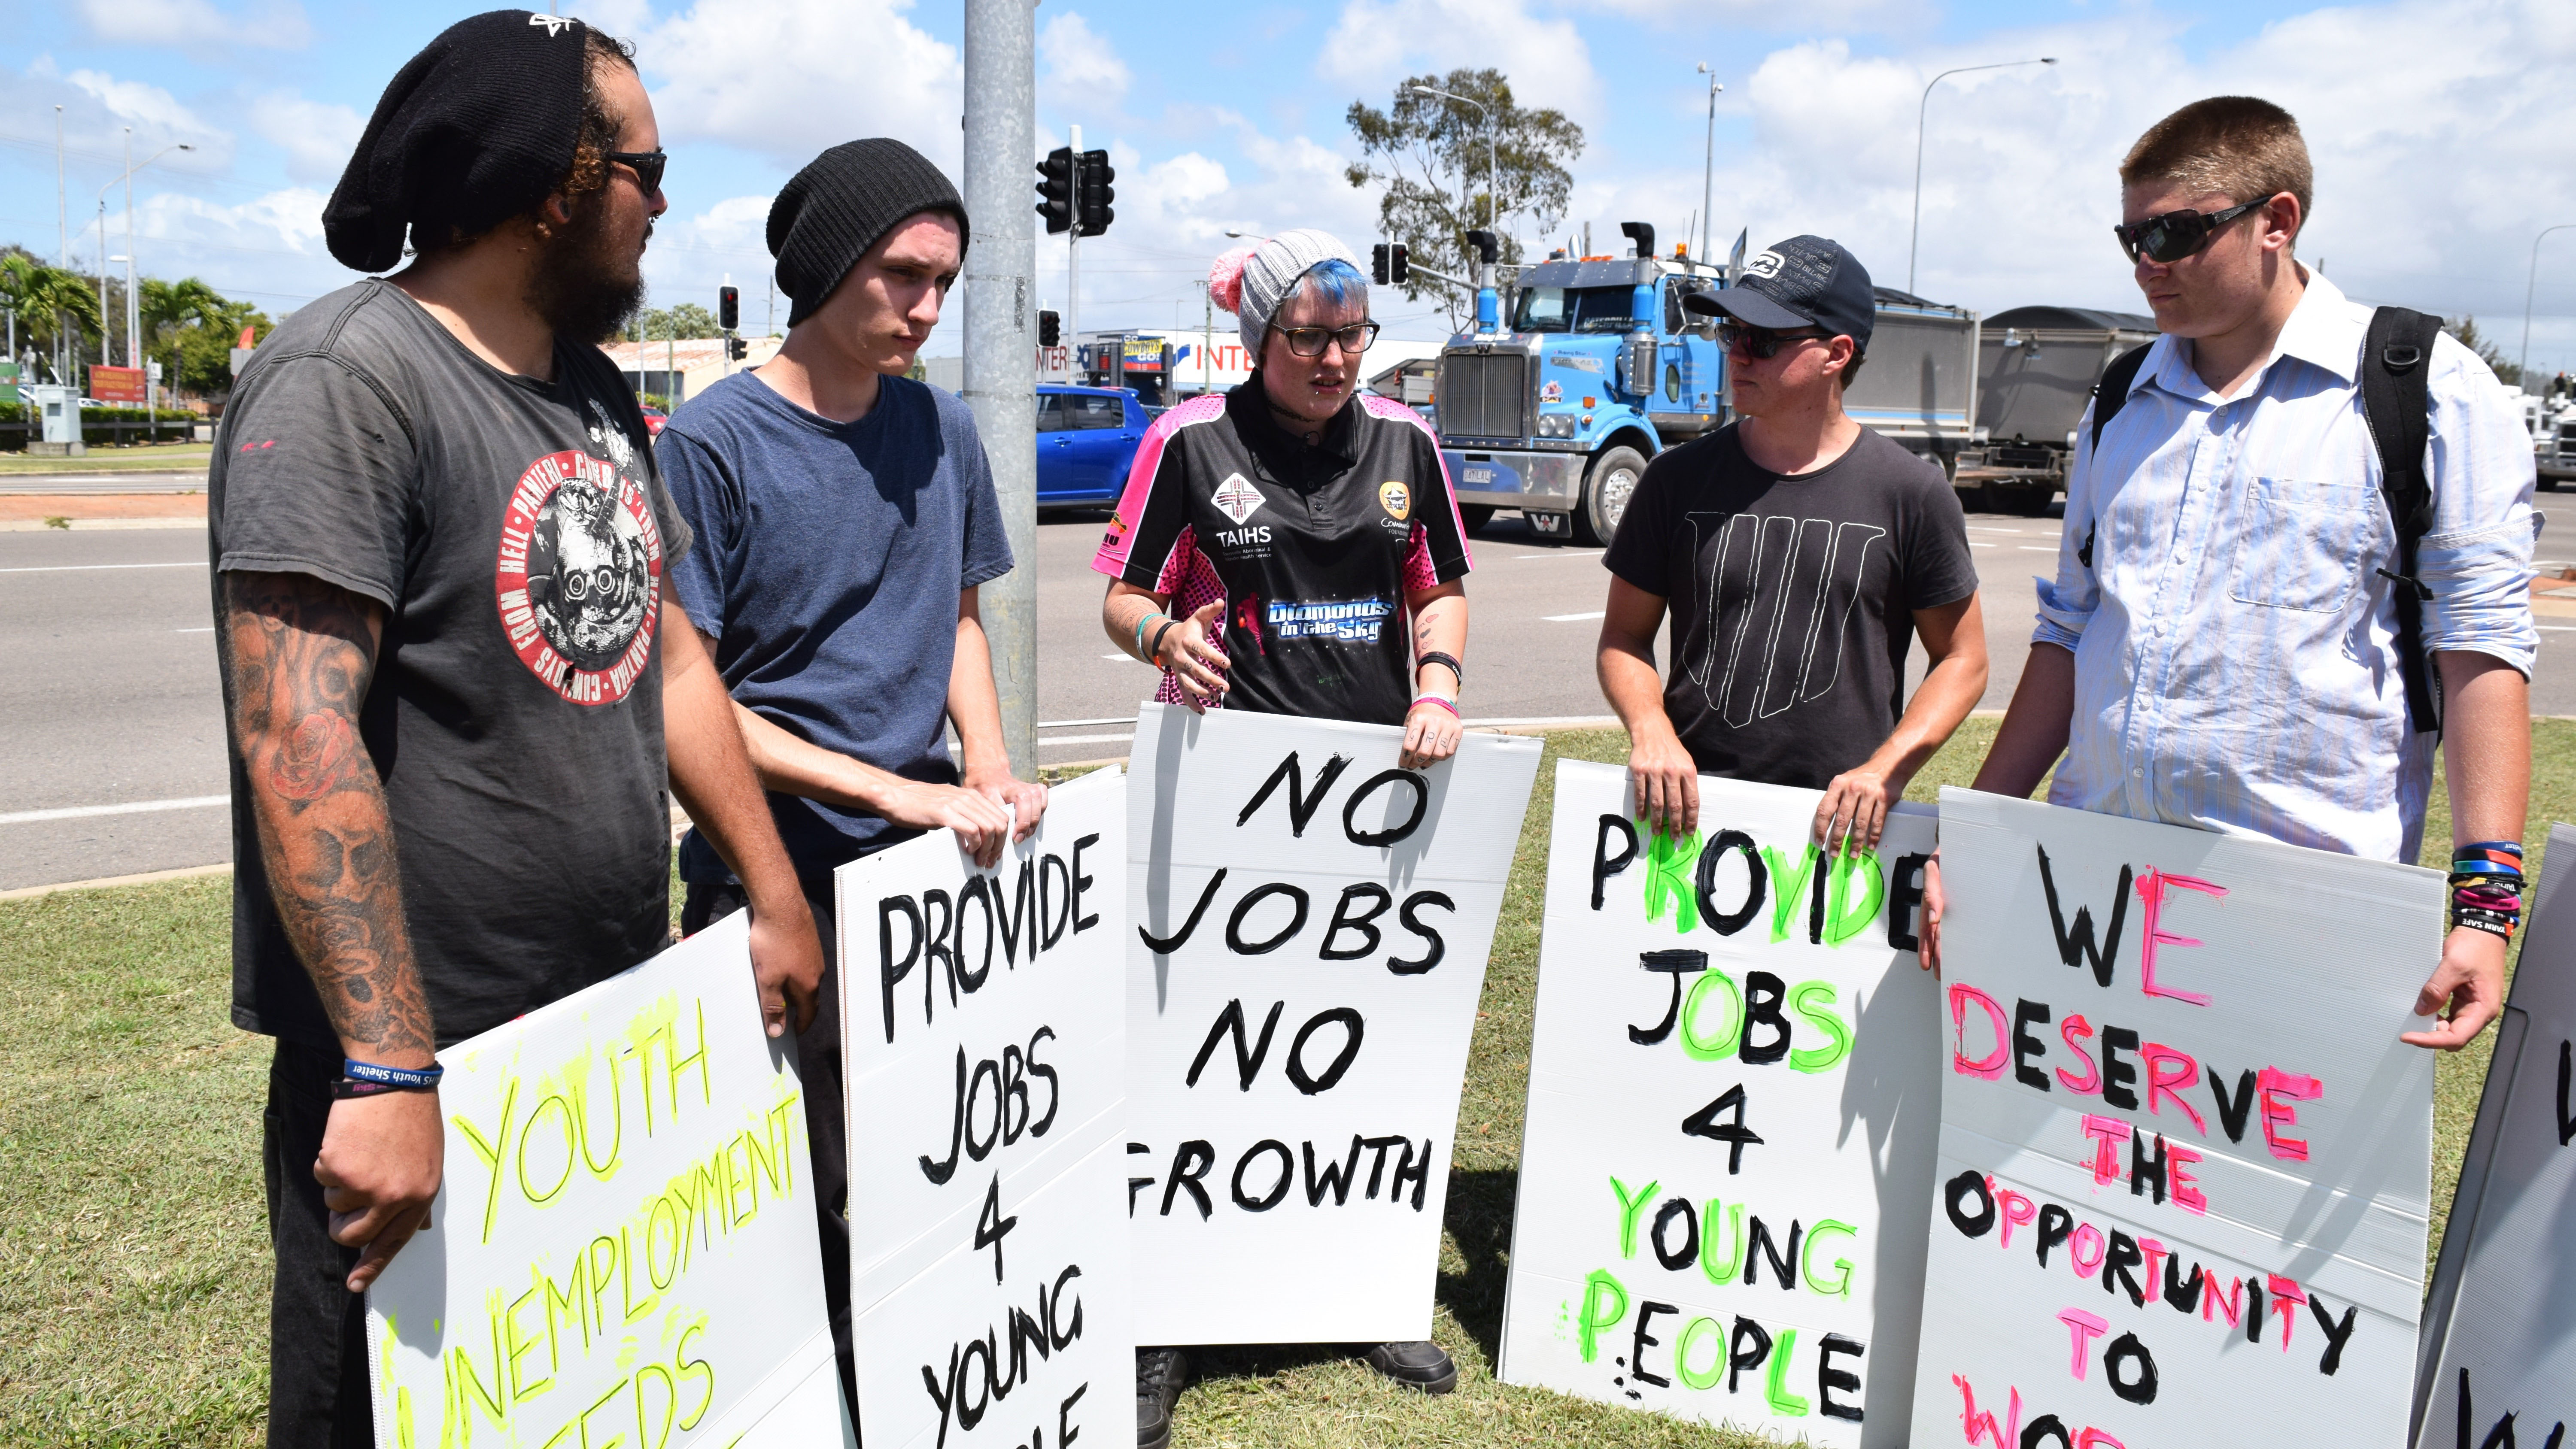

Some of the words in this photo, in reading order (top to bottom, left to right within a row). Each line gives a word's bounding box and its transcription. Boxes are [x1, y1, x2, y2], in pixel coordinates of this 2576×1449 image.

[1137, 353, 1160, 361] GO!
[499, 526, 530, 573] HELL
[638, 504, 660, 562] FROM
[1216, 526, 1271, 548] TAIHS
[500, 588, 540, 651] FROM
[1269, 597, 1393, 623] Diamonds
[1281, 623, 1299, 636] in
[1303, 622, 1337, 634] the
[1337, 620, 1382, 640] Sky
[1236, 751, 1431, 848] NO
[1138, 867, 1456, 976] JOBS
[1591, 813, 1926, 952] PROVIDE
[2037, 840, 2230, 1006] WE
[2462, 918, 2483, 928] SAFE
[2484, 921, 2506, 934] YARN
[879, 832, 1100, 1045] PROVIDE
[1186, 998, 1367, 1096] NO
[1628, 949, 1855, 1074] JOBS
[352, 1065, 391, 1080] Shelter
[393, 1072, 422, 1084] Youth
[451, 998, 712, 1244] YOUTH
[918, 1025, 1058, 1185] JOBS
[1947, 983, 2323, 1161] DESERVE
[1681, 1082, 1765, 1175] 4
[2079, 1113, 2208, 1216] THE
[396, 1091, 799, 1449] UNEMPLOYMENT
[973, 1168, 1019, 1285] 4
[1609, 1174, 1858, 1299] YOUNG
[1944, 1170, 2358, 1376] OPPORTUNITY
[542, 1325, 714, 1449] EDS
[921, 1264, 1084, 1449] YOUNG
[1578, 1268, 1865, 1423] PEOPLE
[2057, 1307, 2158, 1405] TO
